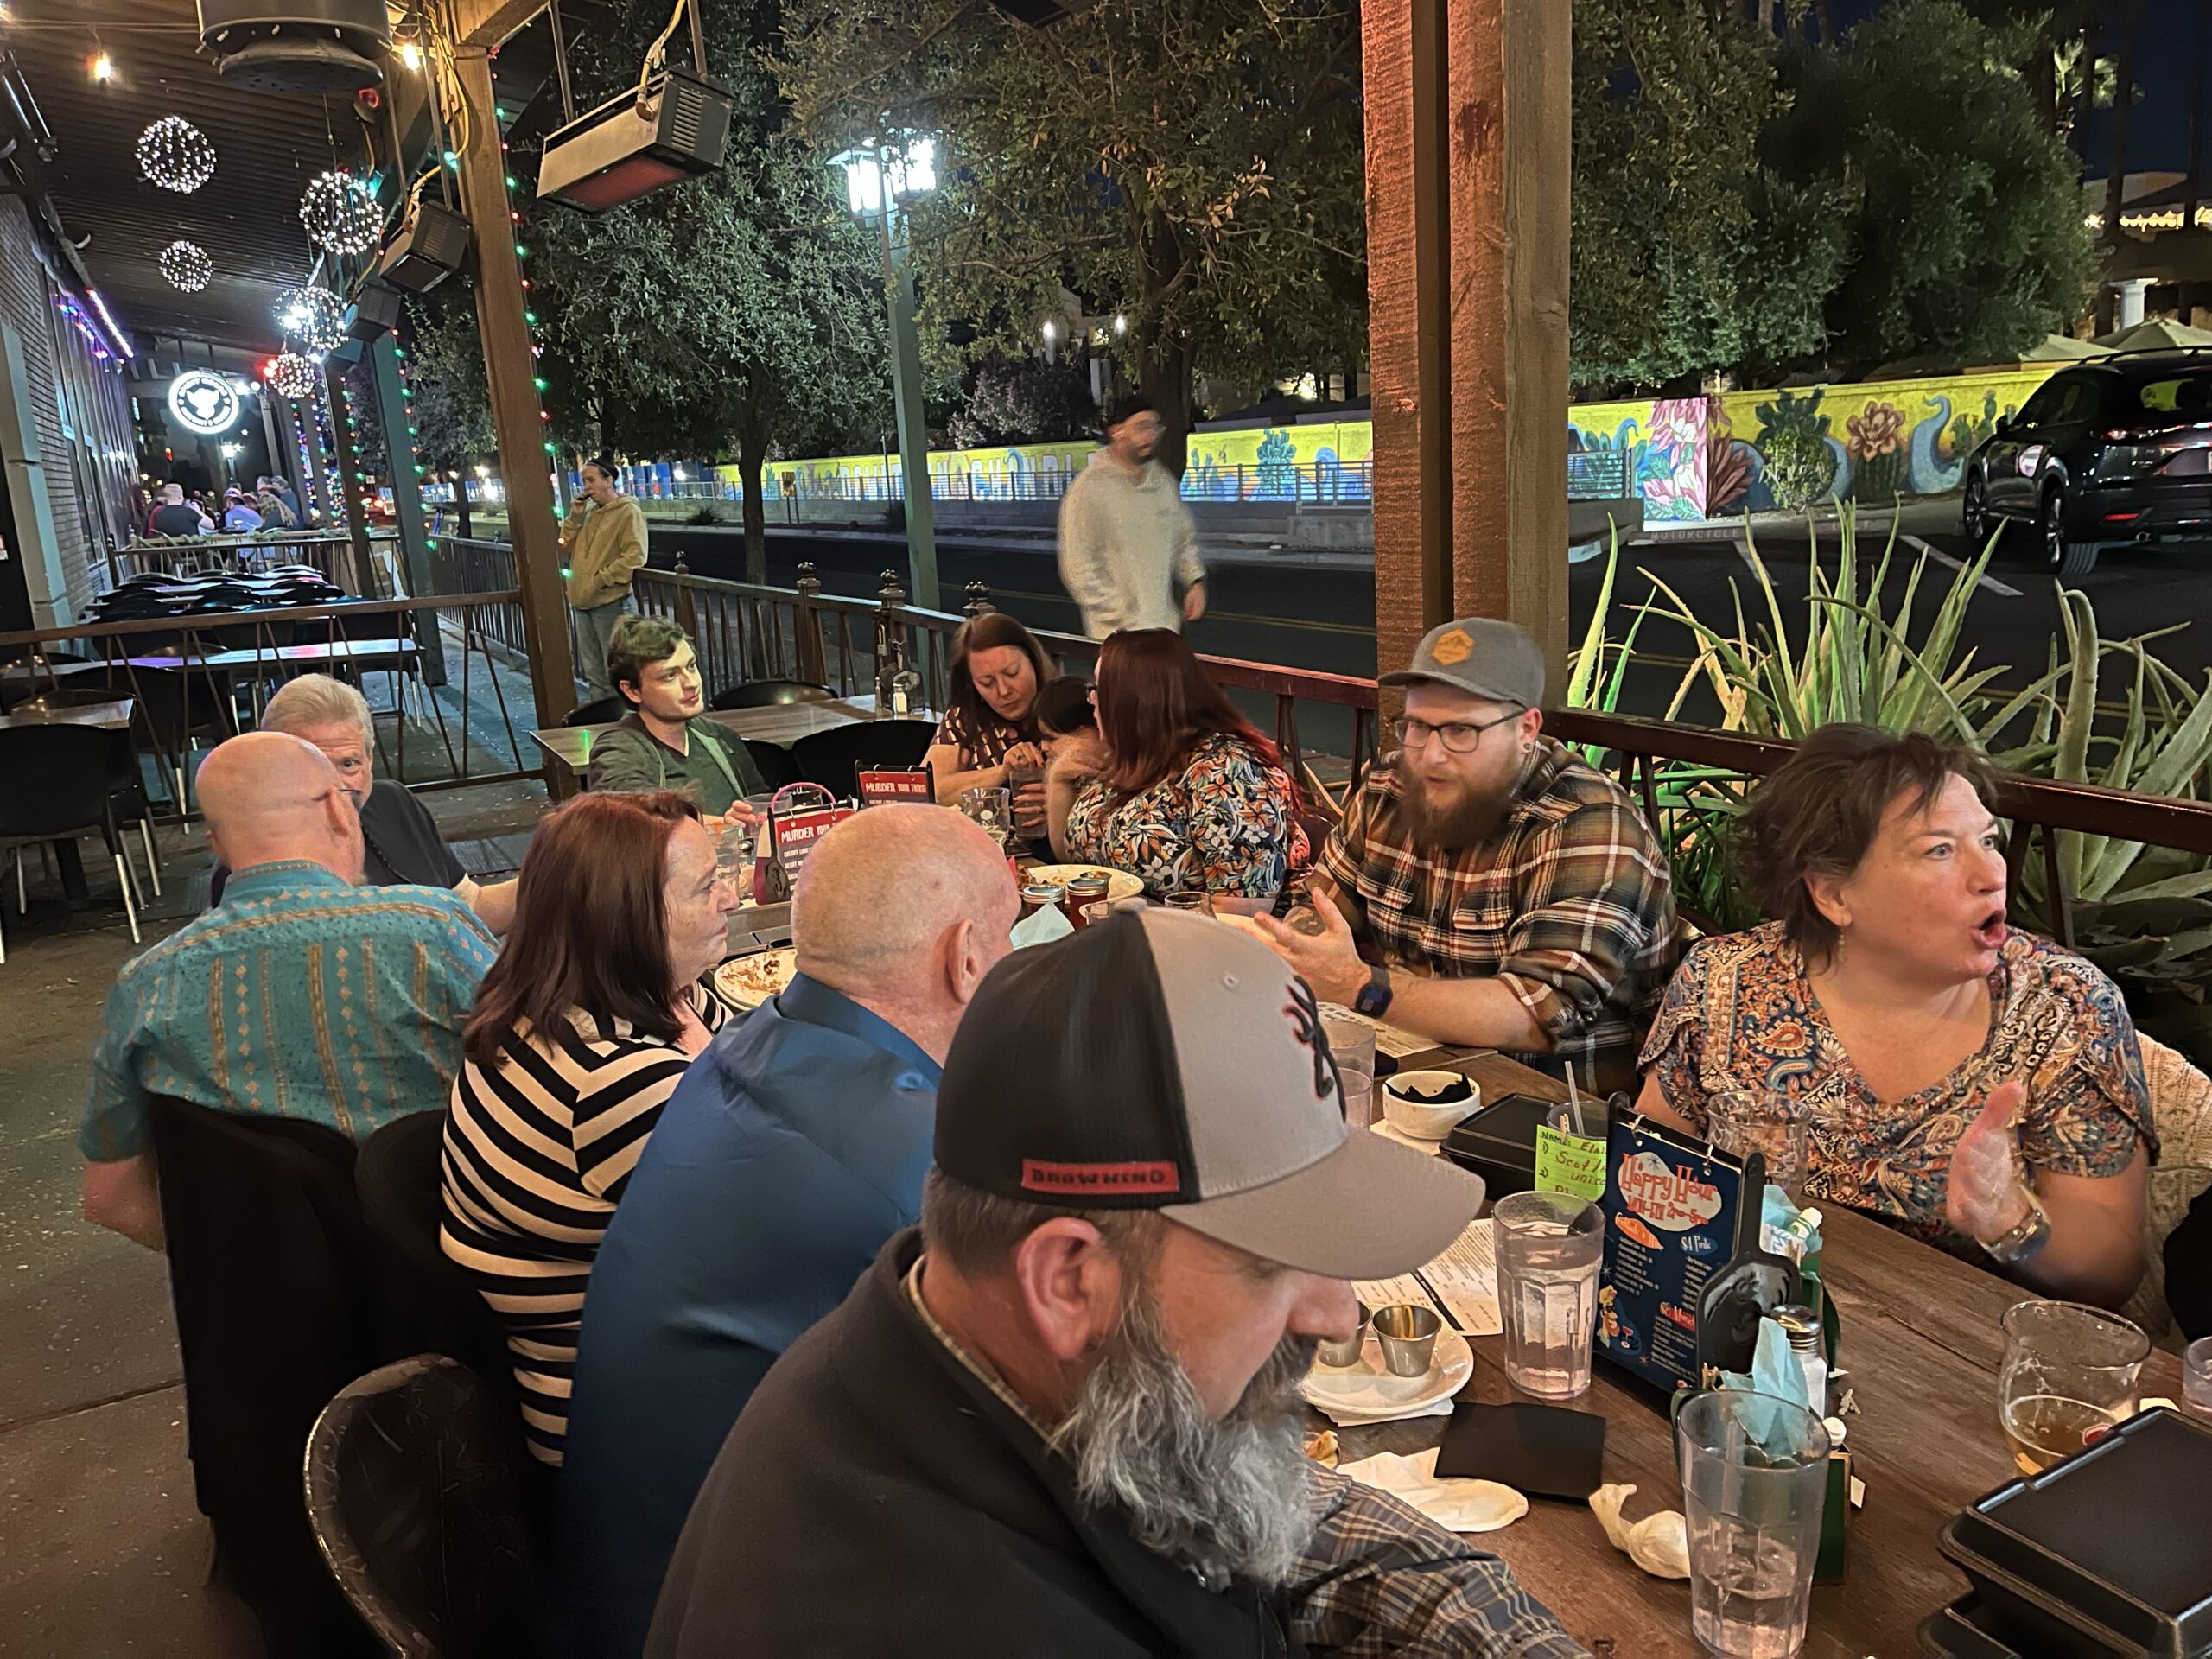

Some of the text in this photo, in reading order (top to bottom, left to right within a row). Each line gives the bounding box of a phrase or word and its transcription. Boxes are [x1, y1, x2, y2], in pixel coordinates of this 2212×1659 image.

[866, 782, 896, 793] MURDER
[781, 826, 815, 843] MURDER
[1621, 1153, 1718, 1205] Happy Hour
